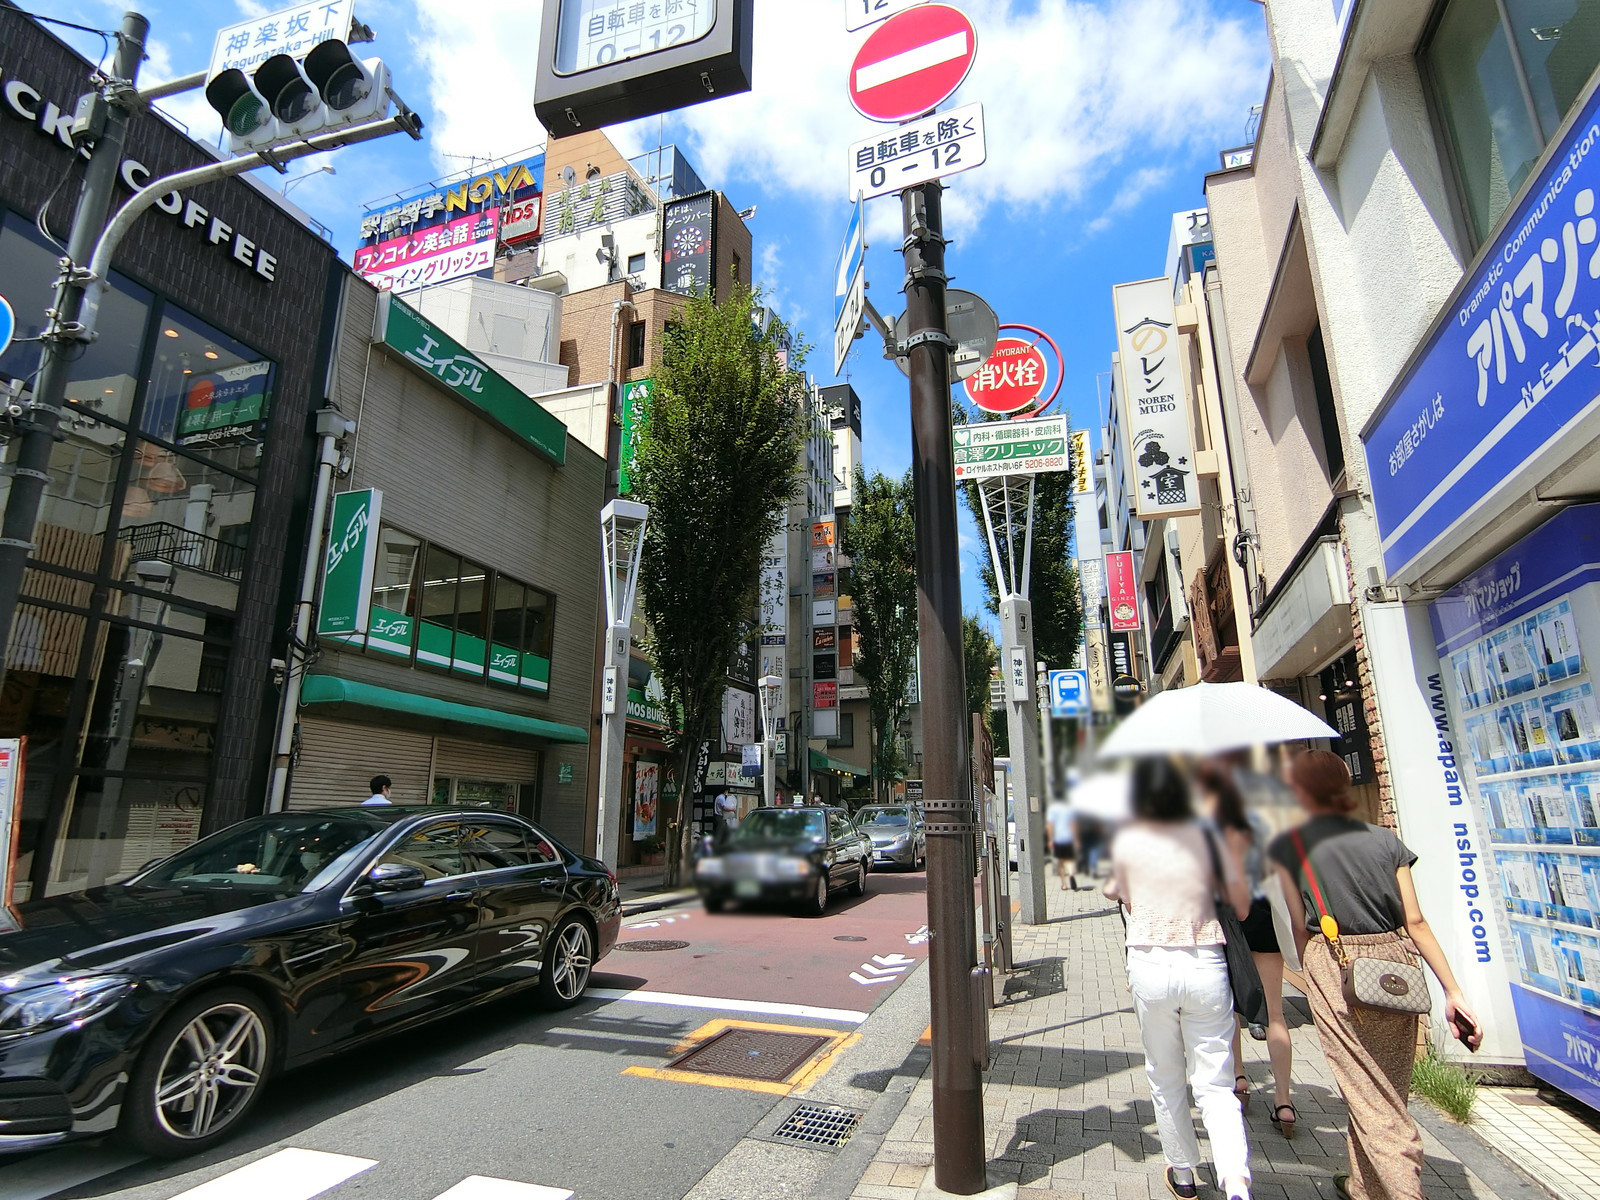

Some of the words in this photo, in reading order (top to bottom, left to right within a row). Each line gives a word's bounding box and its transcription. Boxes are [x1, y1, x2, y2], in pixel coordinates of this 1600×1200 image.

[225, 0, 342, 57] 神楽坂下
[856, 117, 977, 168] 自転車を除く
[446, 164, 536, 212] NOVA
[120, 159, 278, 283] COFFEE
[471, 228, 494, 241] 150m
[1459, 263, 1504, 327] Dramatic
[1503, 124, 1600, 264] Communication
[358, 223, 469, 272] ワンコイン英会話
[473, 218, 493, 230] この先
[404, 333, 488, 393] エイブル
[996, 346, 1031, 356] HYDRANT
[972, 358, 1039, 392] 消火栓
[1138, 394, 1174, 406] NOREN
[1139, 402, 1176, 415] MURO
[1388, 392, 1445, 477] お部屋さがしは
[954, 440, 1063, 464] 倉澤クリニック
[1024, 457, 1064, 469] 5206-8820
[327, 503, 369, 574] エイブル
[765, 557, 781, 567] 3F
[1115, 555, 1126, 595] FUJIYA
[1464, 561, 1521, 618] アパマンショップ
[371, 618, 408, 637] エイブル
[490, 653, 517, 669] エイブル
[1013, 658, 1024, 687] 神楽坂
[627, 701, 646, 718] MOS
